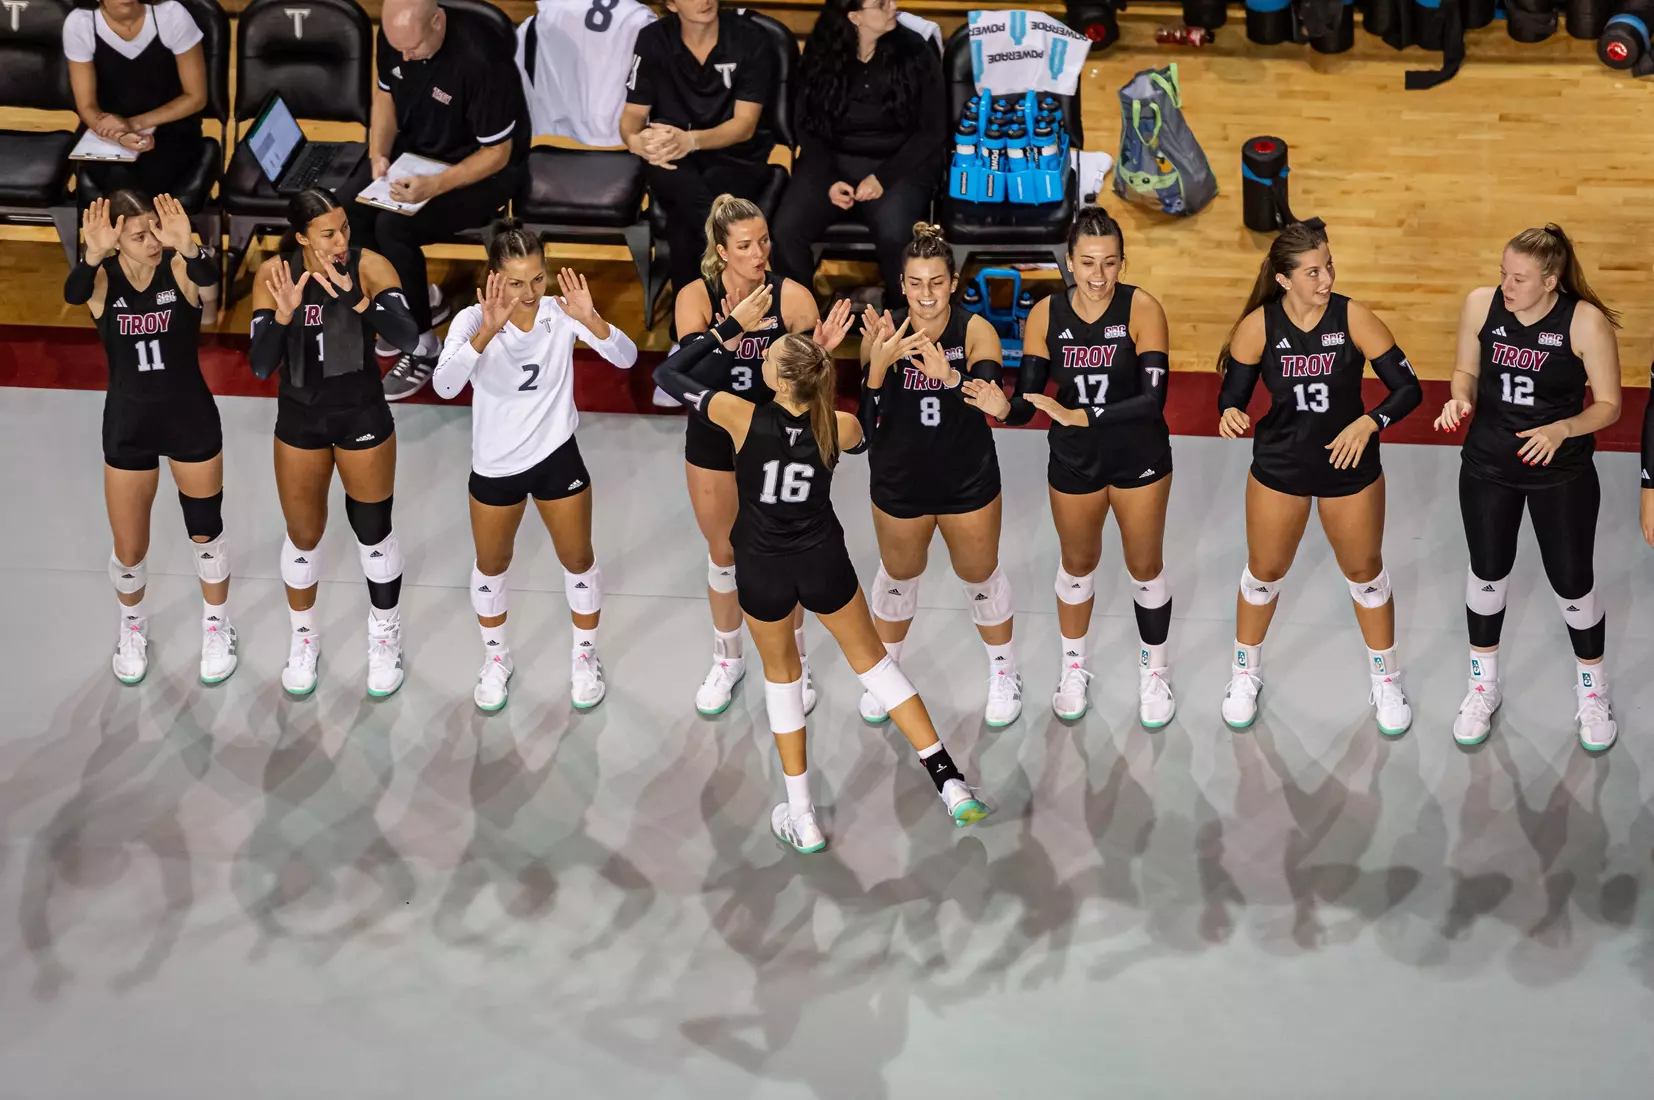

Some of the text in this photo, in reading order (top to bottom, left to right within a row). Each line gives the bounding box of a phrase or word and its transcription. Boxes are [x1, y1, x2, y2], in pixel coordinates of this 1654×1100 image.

[585, 0, 619, 32] 8
[987, 49, 1044, 64] POWERADE
[117, 309, 172, 335] TROY
[1104, 324, 1127, 339] SBC
[1321, 332, 1345, 347] SBC
[1538, 331, 1564, 347] SBC
[134, 339, 166, 372] 11
[1062, 344, 1118, 368] TROY
[1280, 352, 1337, 377] TROY
[1492, 341, 1549, 372] TROY
[518, 363, 540, 392] 2
[730, 365, 753, 391] 3
[903, 367, 957, 391] TRO
[1073, 373, 1110, 405] 17
[1500, 372, 1535, 406] 12
[1293, 382, 1330, 413] 13
[920, 396, 941, 427] 8
[759, 459, 815, 505] 16
